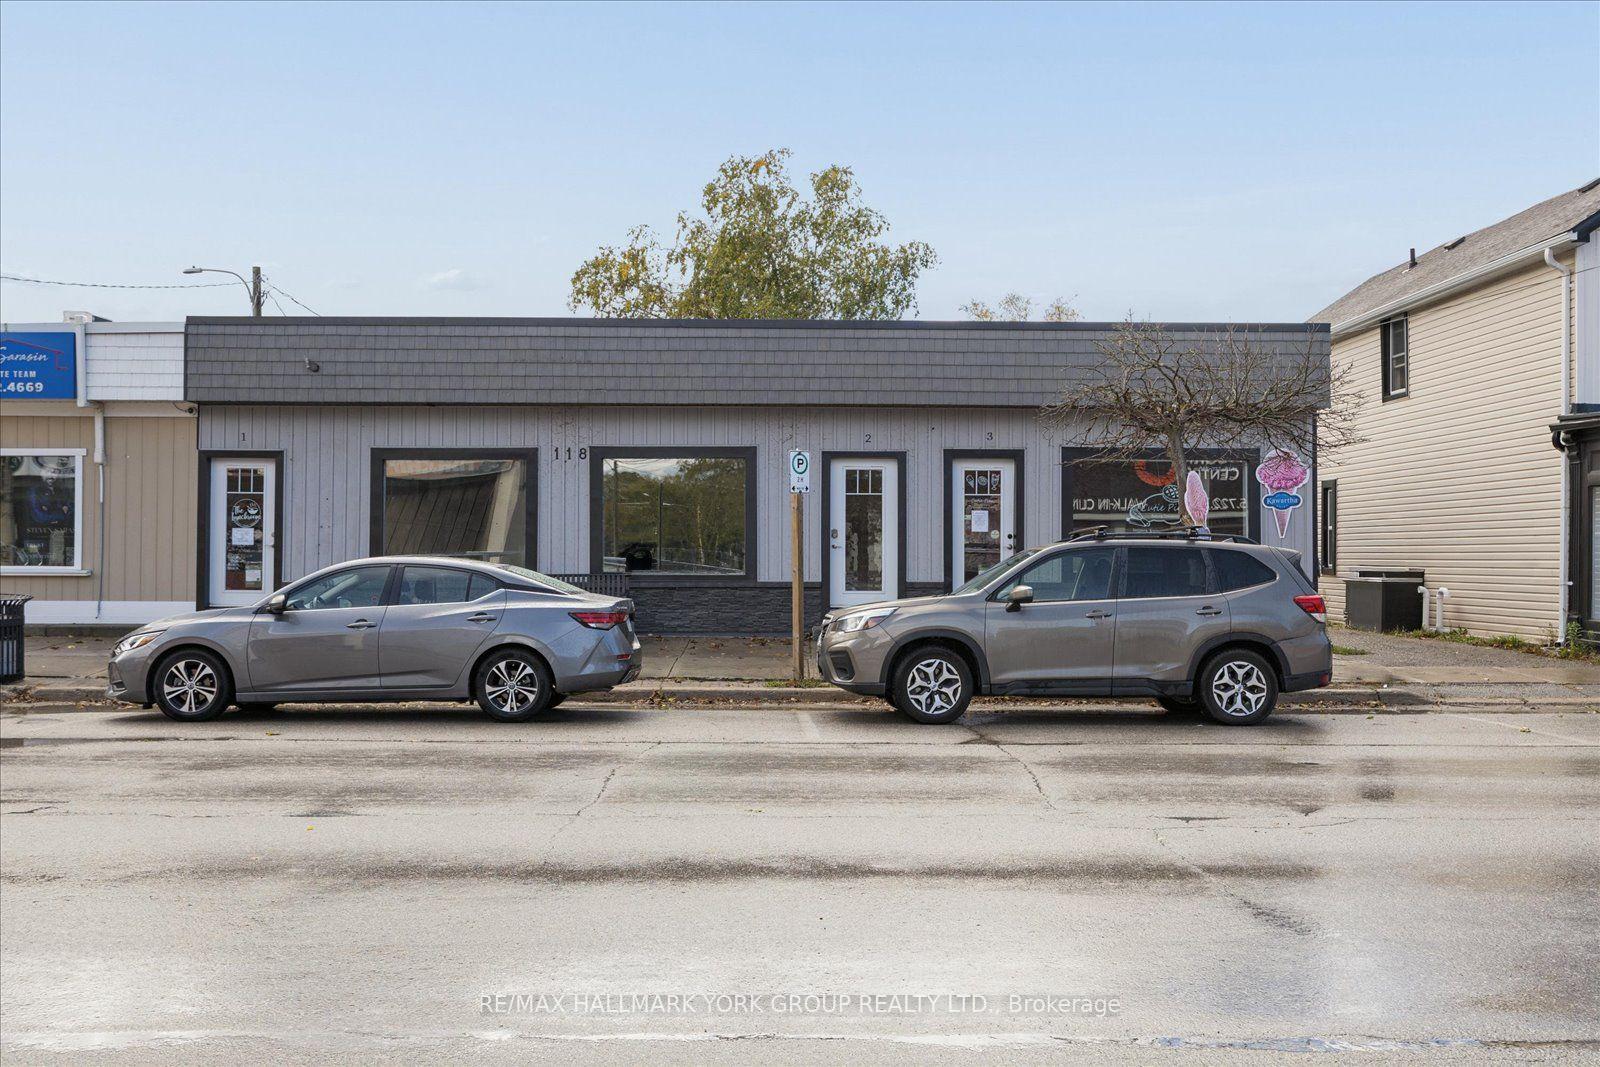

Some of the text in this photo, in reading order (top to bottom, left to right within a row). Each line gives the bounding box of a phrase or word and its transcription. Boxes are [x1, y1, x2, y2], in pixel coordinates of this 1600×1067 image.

[13, 370, 37, 378] TEAM
[240, 432, 246, 441] 1
[865, 433, 872, 443] 2
[986, 431, 993, 441] 3
[554, 447, 587, 460] 118
[797, 458, 804, 469] P
[1266, 496, 1299, 506] Kawartha
